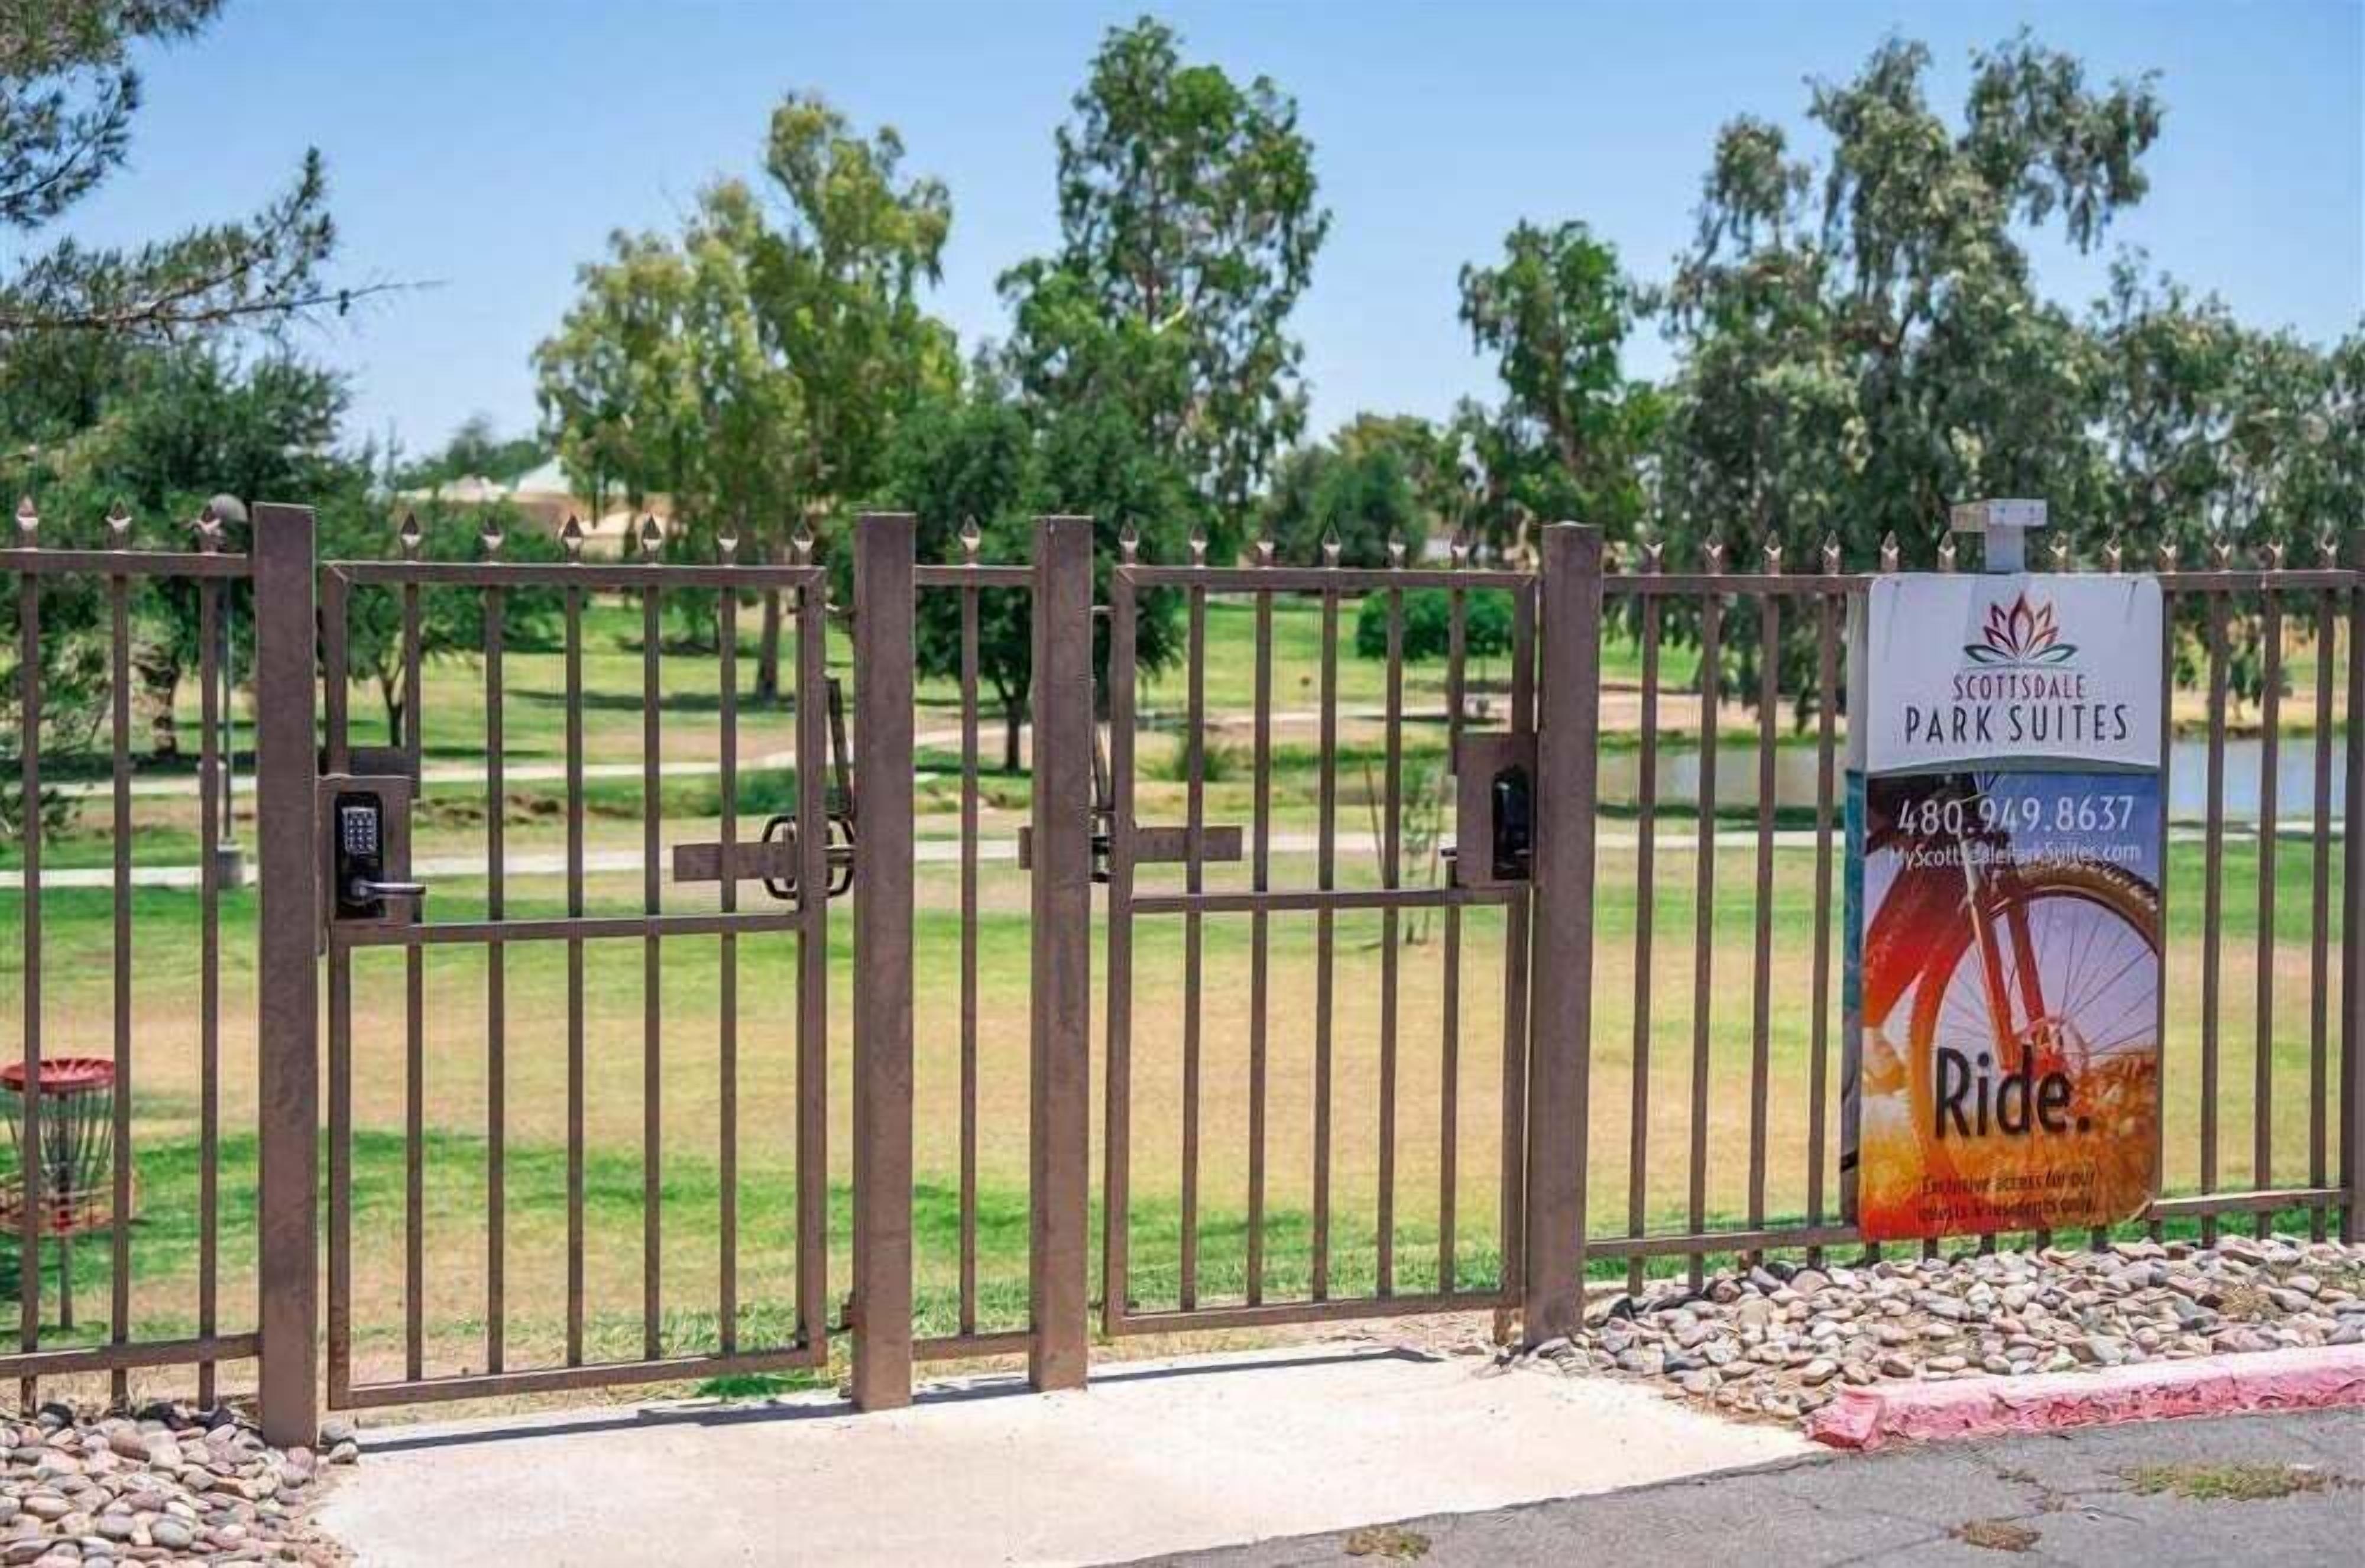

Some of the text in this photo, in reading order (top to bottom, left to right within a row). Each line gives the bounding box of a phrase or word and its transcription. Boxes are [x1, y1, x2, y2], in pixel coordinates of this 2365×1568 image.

[1953, 673, 2086, 701] SCOTTSDALE
[1904, 704, 2128, 745] PARK SUITES
[1897, 794, 2135, 836] 480.949.8637
[1888, 842, 2142, 870] MyScottaleParkSuites.com
[1935, 1044, 2092, 1138] Ride.
